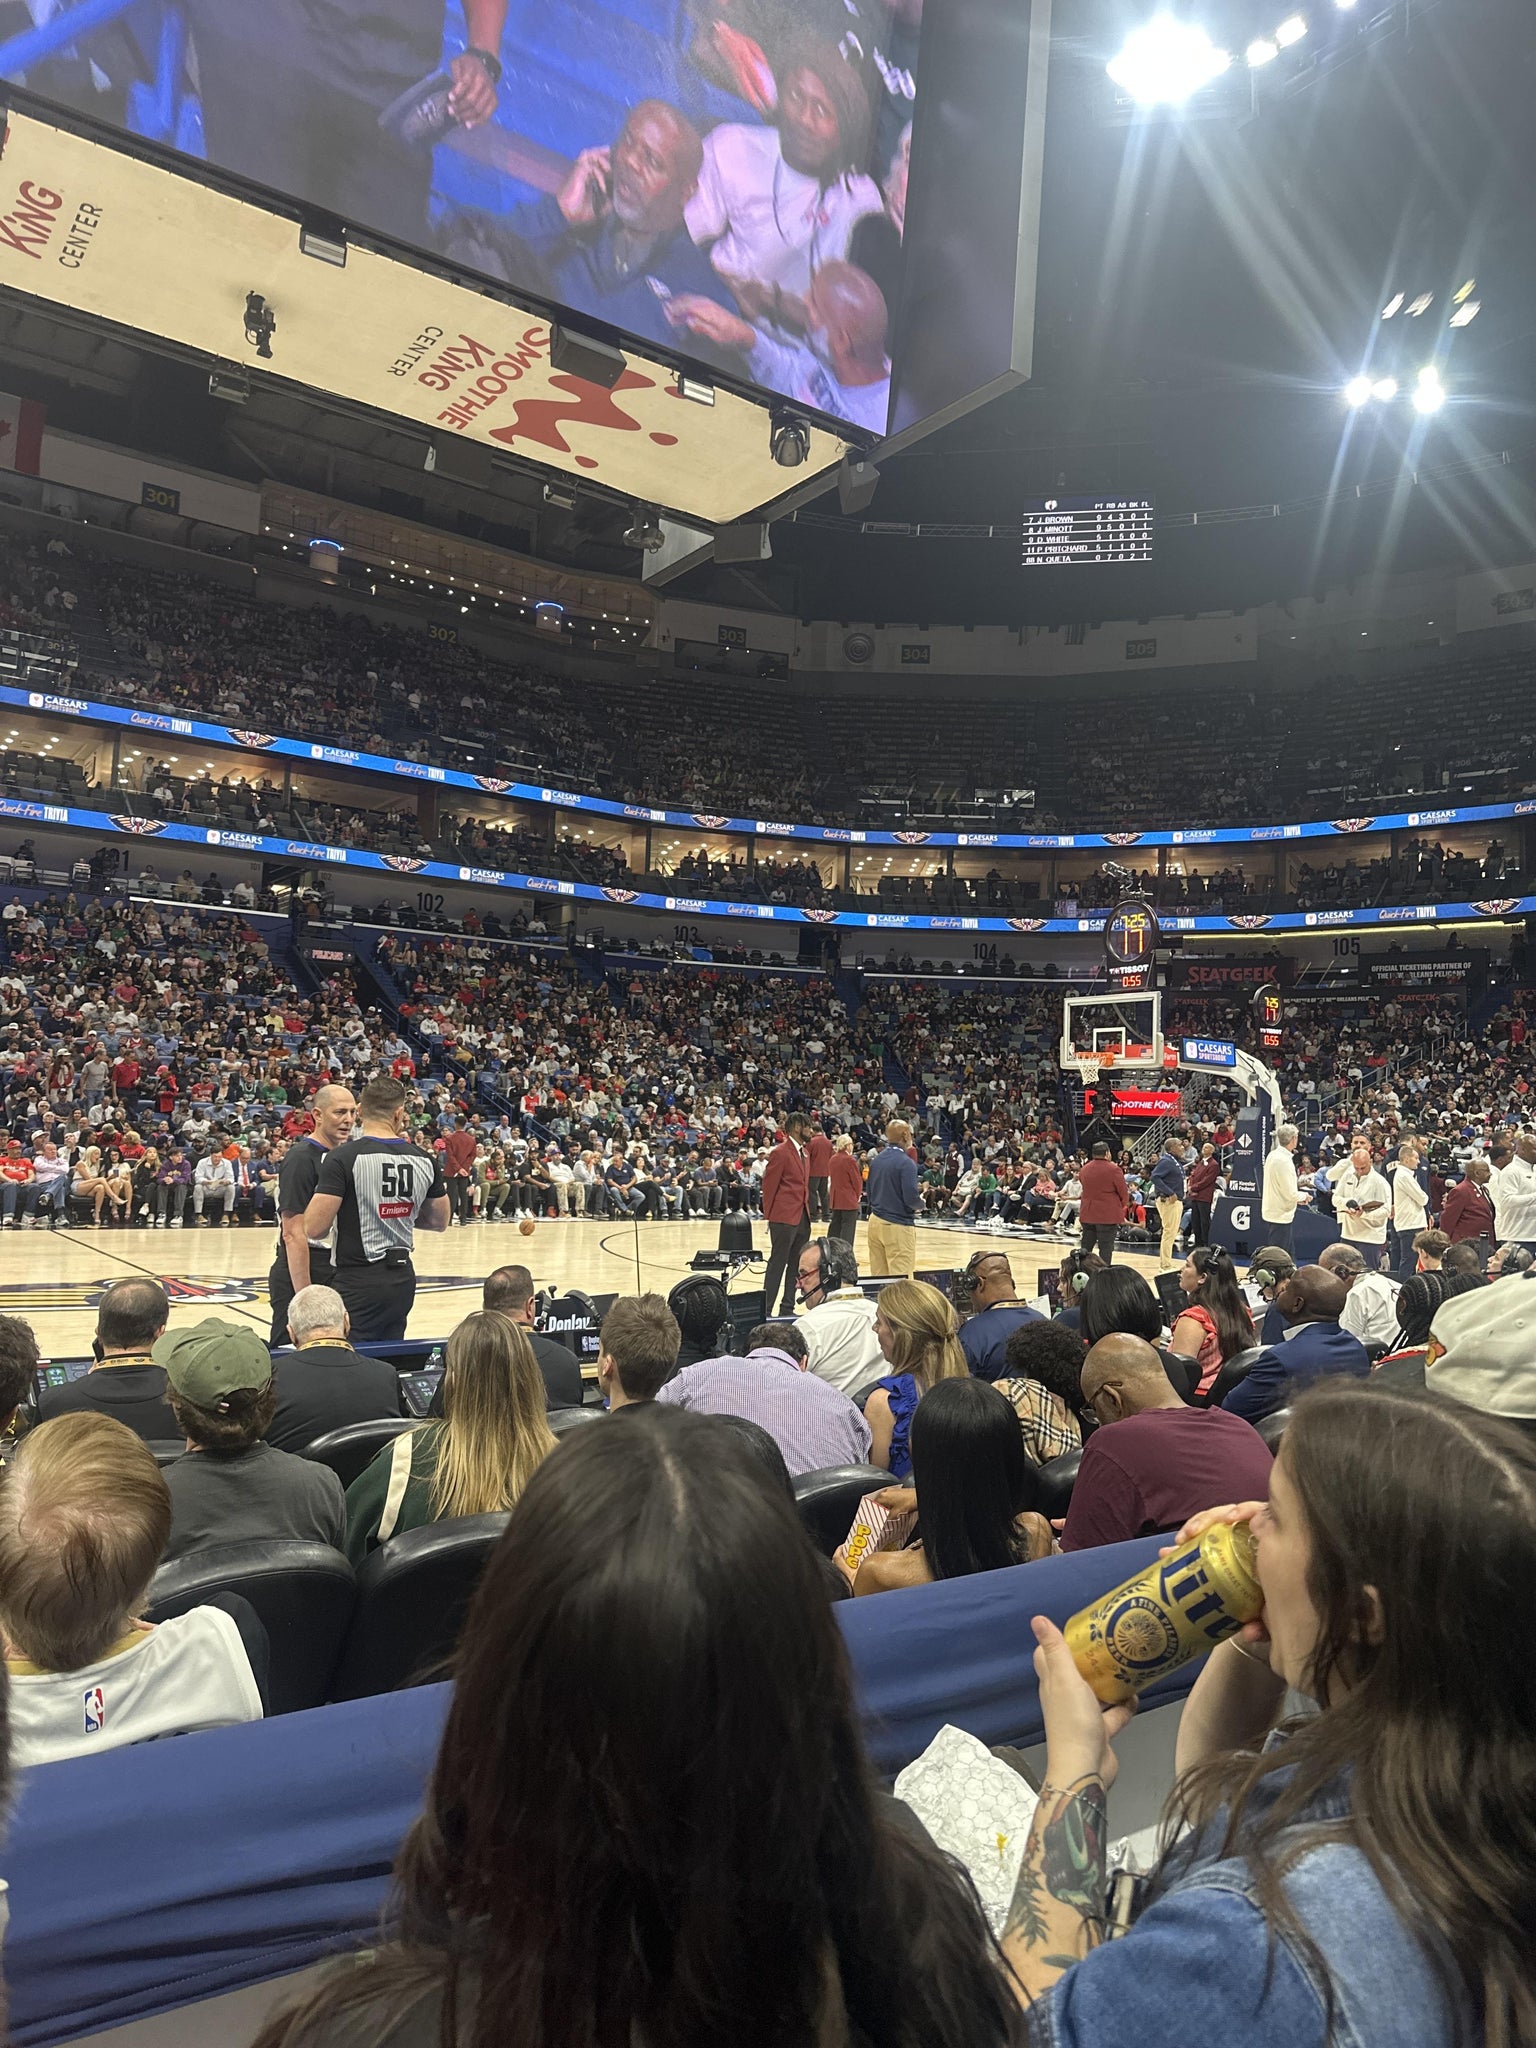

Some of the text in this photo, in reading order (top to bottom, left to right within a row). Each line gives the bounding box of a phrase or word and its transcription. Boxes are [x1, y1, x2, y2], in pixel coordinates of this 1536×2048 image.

[58, 202, 104, 269] CENTER
[386, 326, 444, 377] CENTER
[436, 326, 551, 430] SMOOTHIE
[146, 487, 177, 508] 301
[1045, 516, 1074, 524] BROWN
[1046, 535, 1070, 543] WHITE
[1044, 544, 1088, 553] PRITCHARD
[429, 624, 457, 644] 302
[720, 628, 745, 643] 303
[903, 648, 929, 660] 304
[1127, 642, 1155, 656] 305
[45, 695, 88, 711] CAESARS
[130, 712, 192, 734] Quick-Fire TRIVIA
[324, 747, 360, 761] CAESARS
[427, 767, 446, 781] TRIVIA
[553, 790, 581, 802] CAESARS
[44, 806, 69, 822] TRIVIA
[1420, 810, 1456, 819] CAESARS
[1514, 803, 1536, 814] Quick-
[766, 822, 795, 832] CAESARS
[222, 832, 263, 845] CAESARS
[968, 834, 998, 842] CAESARS
[1184, 830, 1217, 838] CAESARS
[287, 843, 347, 861] Quick-Fire TRIVIA
[471, 869, 505, 880] CAESARS
[417, 892, 444, 914] 102
[676, 898, 707, 909] CAESARS
[758, 906, 774, 917] TRIVIA
[1318, 910, 1354, 919] CAESARS
[1379, 906, 1436, 920] Quick-Fire TRIVIA
[878, 915, 909, 923] CAESARS
[1121, 913, 1146, 930] 7:25
[1177, 918, 1195, 929] TRIVIA
[674, 925, 698, 945] 103
[1124, 929, 1144, 956] 17
[1332, 936, 1361, 956] 105
[973, 943, 998, 960] 104
[1120, 964, 1149, 975] TISSOT
[1188, 965, 1278, 983] SEATGEEK
[1371, 965, 1399, 973] OFFICIAL
[1399, 963, 1432, 972] TICKETING
[1432, 962, 1463, 971] PARTNER
[1122, 975, 1142, 987] 0:55
[1377, 972, 1390, 980] THE
[1265, 1008, 1277, 1021] 17
[1198, 1043, 1232, 1056] CAESARS
[1198, 1052, 1226, 1062] SPORTSBOOK
[381, 1162, 414, 1198] 50
[381, 1206, 409, 1215] Emirates
[1160, 1545, 1244, 1639] Lite
[1138, 1599, 1161, 1618] FINE
